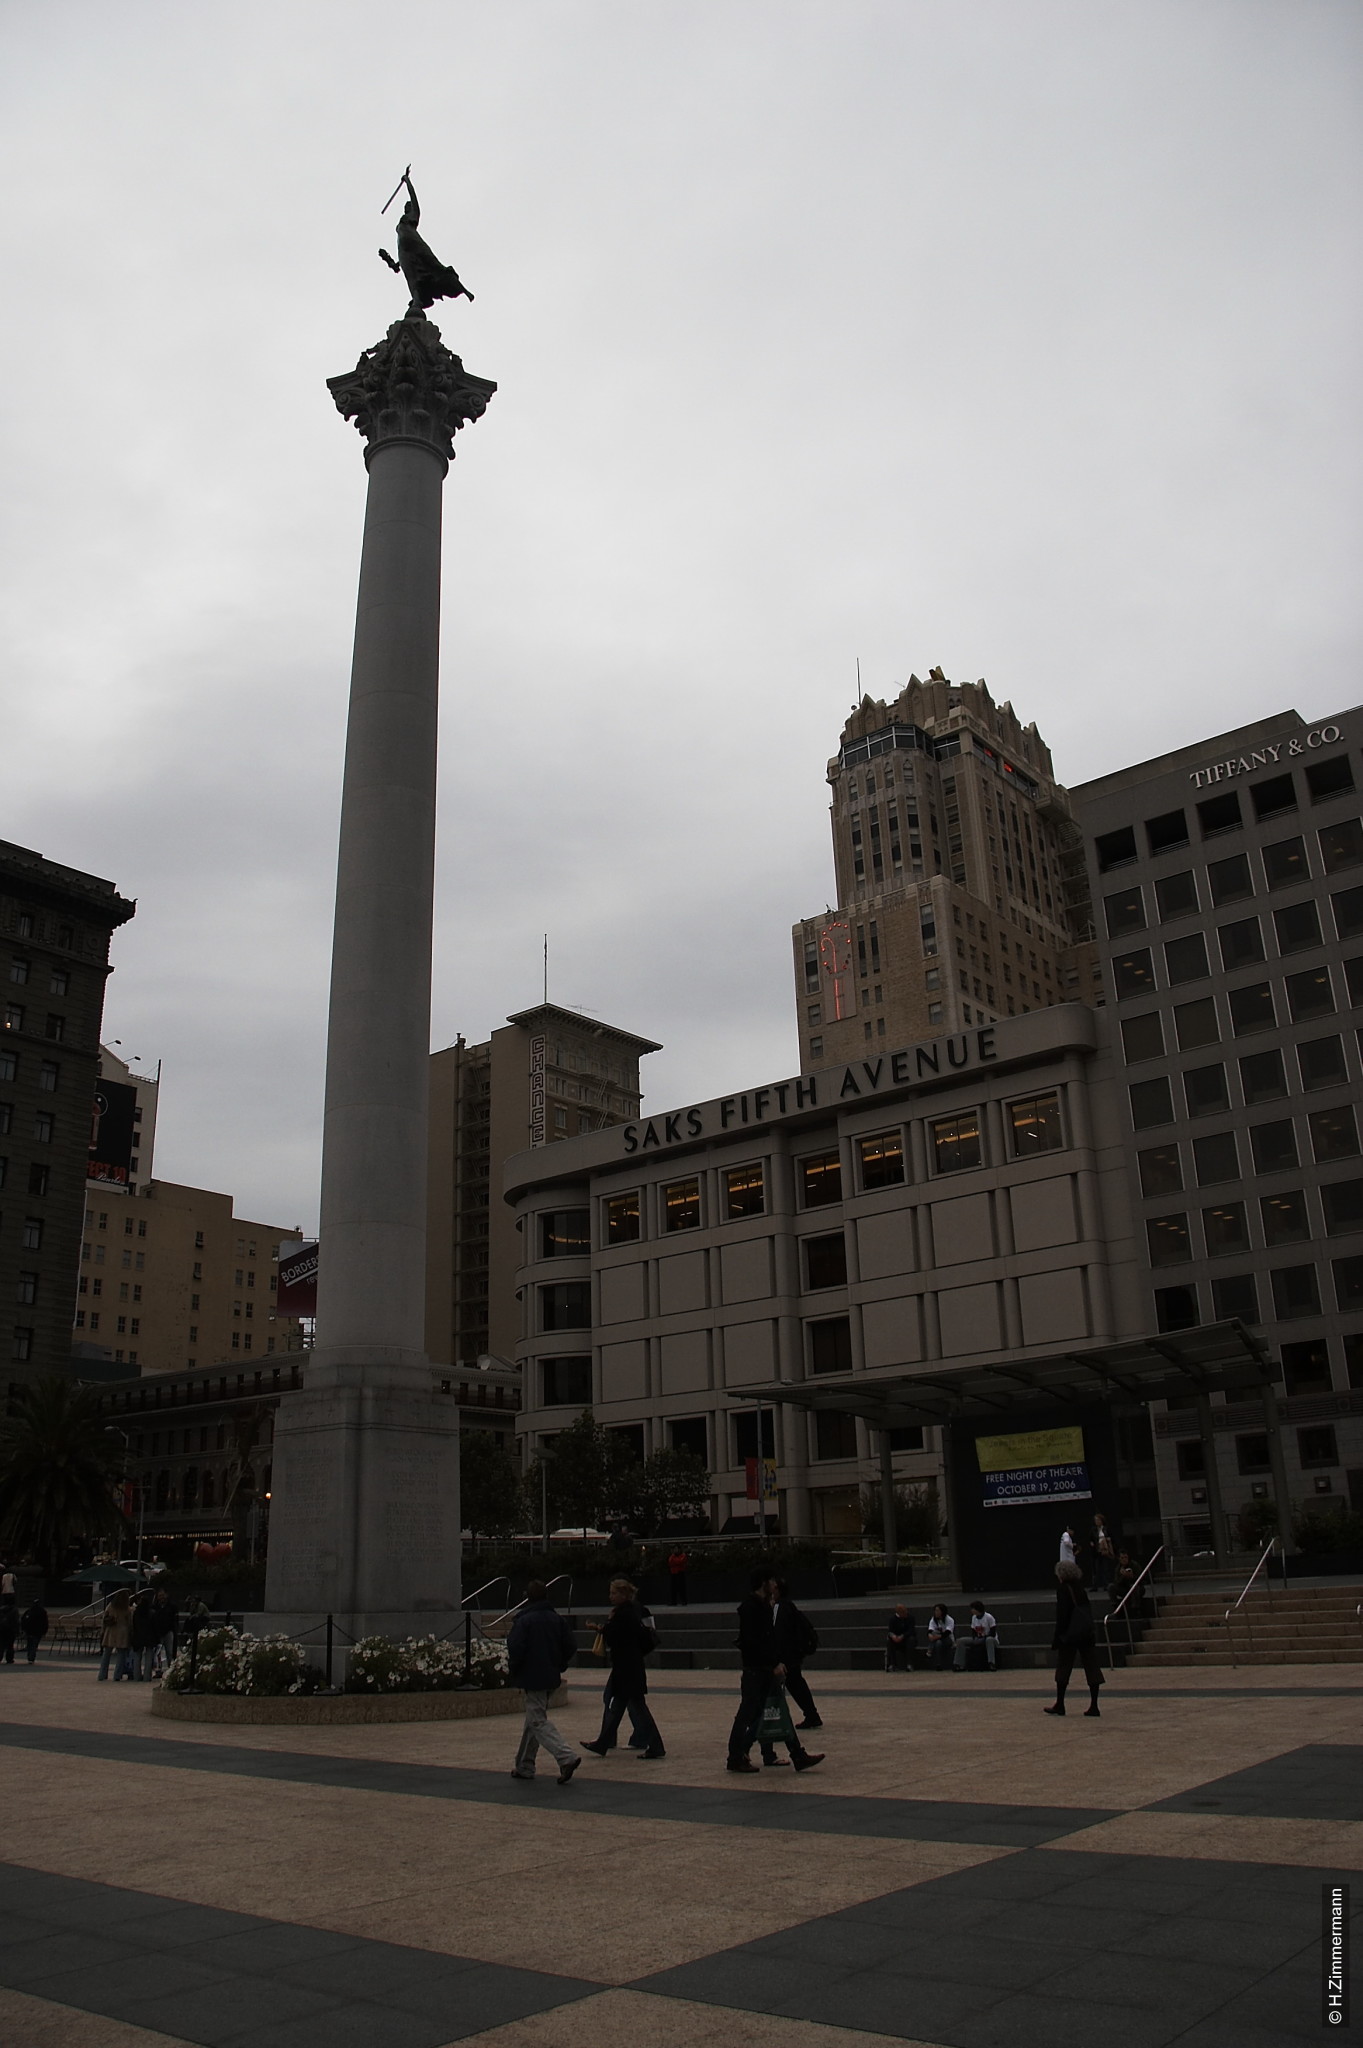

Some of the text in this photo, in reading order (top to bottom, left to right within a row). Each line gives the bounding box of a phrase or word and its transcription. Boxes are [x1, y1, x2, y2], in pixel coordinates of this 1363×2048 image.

[1190, 725, 1345, 789] TIFFANY & CO.
[531, 1037, 544, 1149] CHANCE
[624, 1027, 997, 1152] SAKS FIFTH AVENUE
[985, 1473, 1005, 1484] FREE
[1006, 1471, 1034, 1482] NIGHT
[1035, 1470, 1048, 1480] OF
[997, 1480, 1076, 1496] OCTOBER 19, 2006
